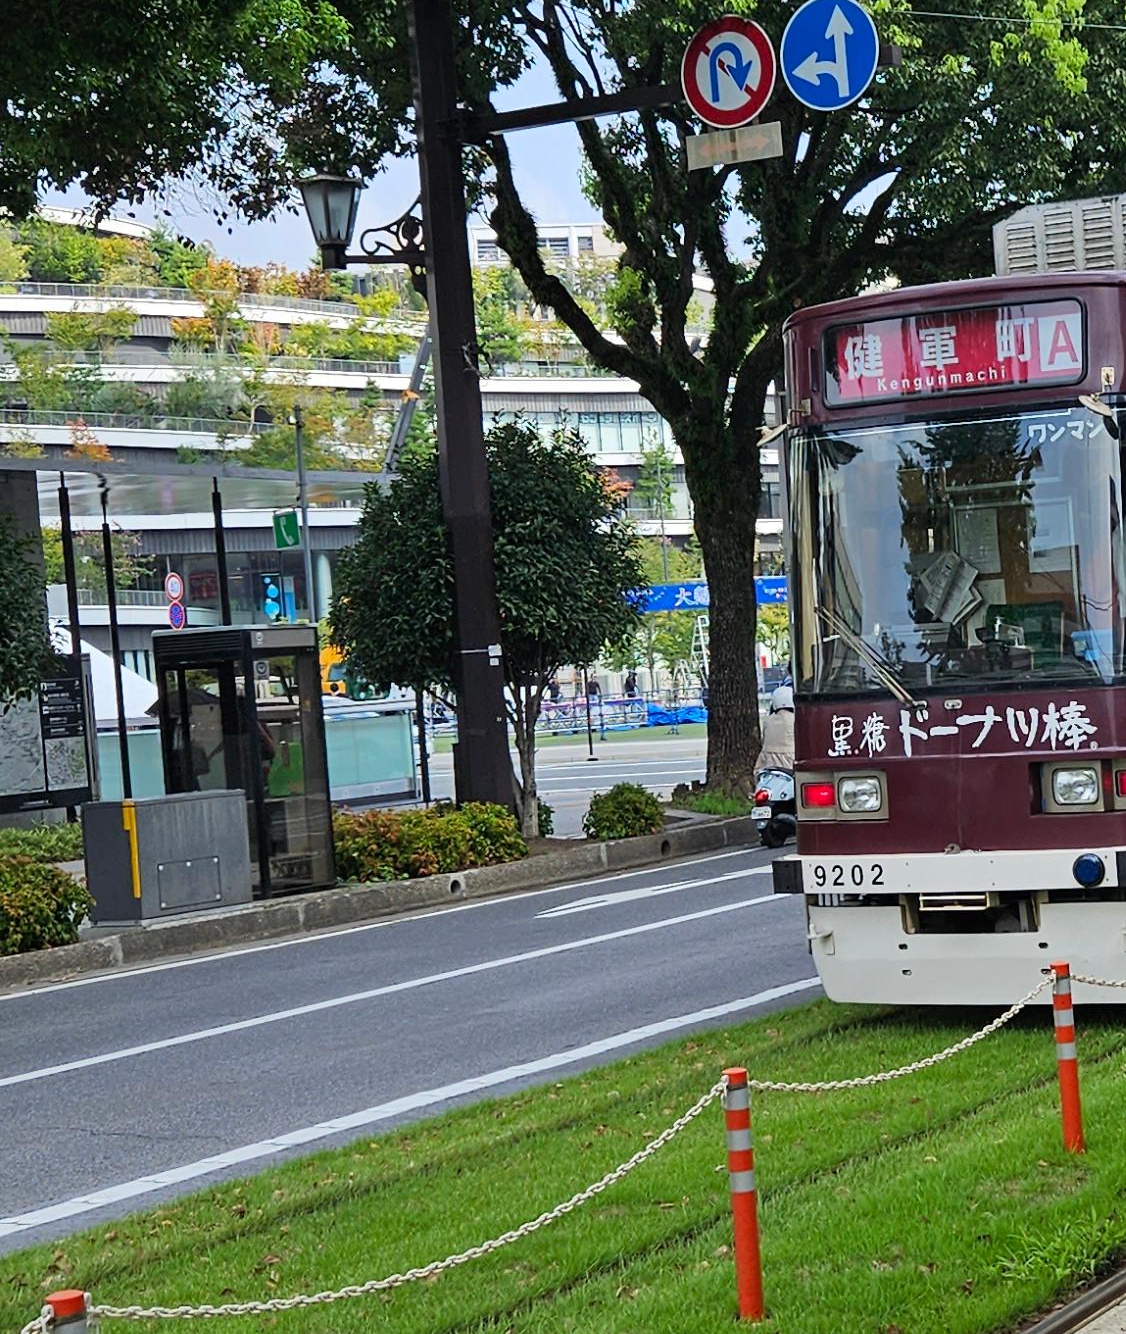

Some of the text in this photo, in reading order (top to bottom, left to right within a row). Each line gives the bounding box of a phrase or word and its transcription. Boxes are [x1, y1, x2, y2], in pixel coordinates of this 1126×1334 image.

[844, 316, 1034, 380] 健軍町
[1048, 320, 1079, 366] A
[877, 365, 1007, 392] Kengunmachi
[1028, 420, 1101, 443] ワンマン
[813, 863, 885, 887] 9202
